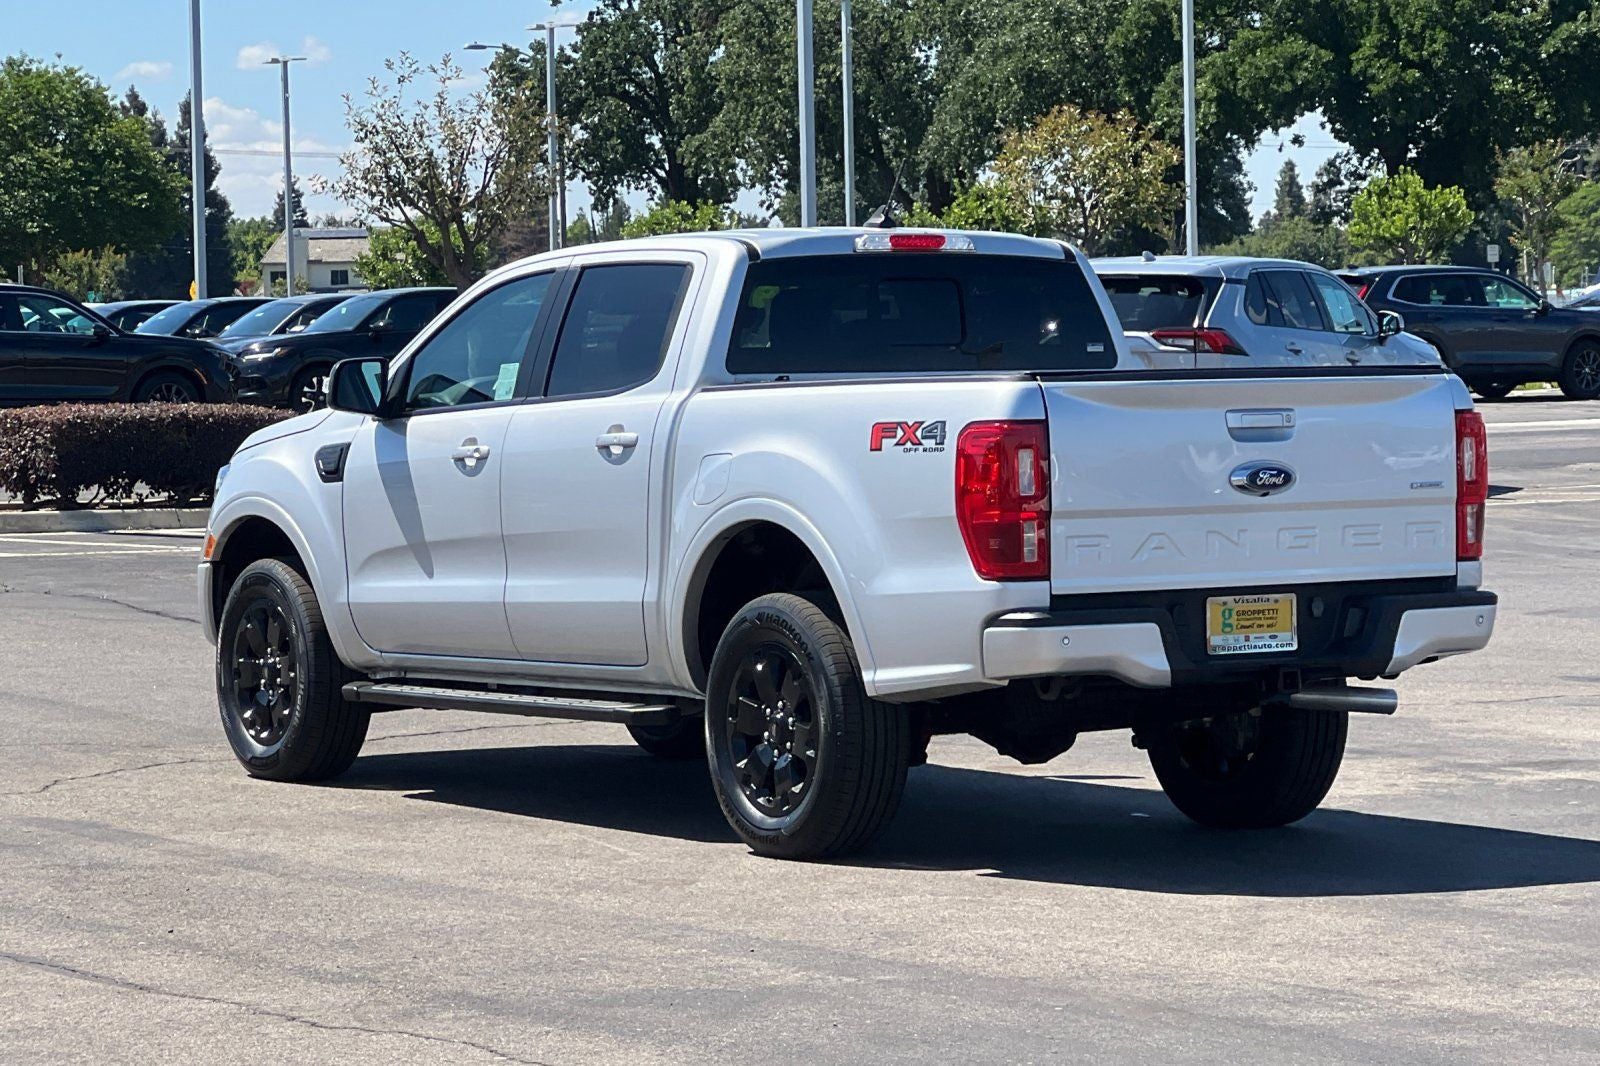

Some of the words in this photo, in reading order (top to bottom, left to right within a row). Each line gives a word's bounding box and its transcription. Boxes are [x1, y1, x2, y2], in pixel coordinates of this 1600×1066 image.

[870, 420, 946, 451] FX4
[1257, 470, 1285, 485] Ford
[1065, 521, 1445, 566] RANGER
[1236, 608, 1279, 617] GROPPETTI
[1211, 642, 1294, 653] groppettiauto.com
